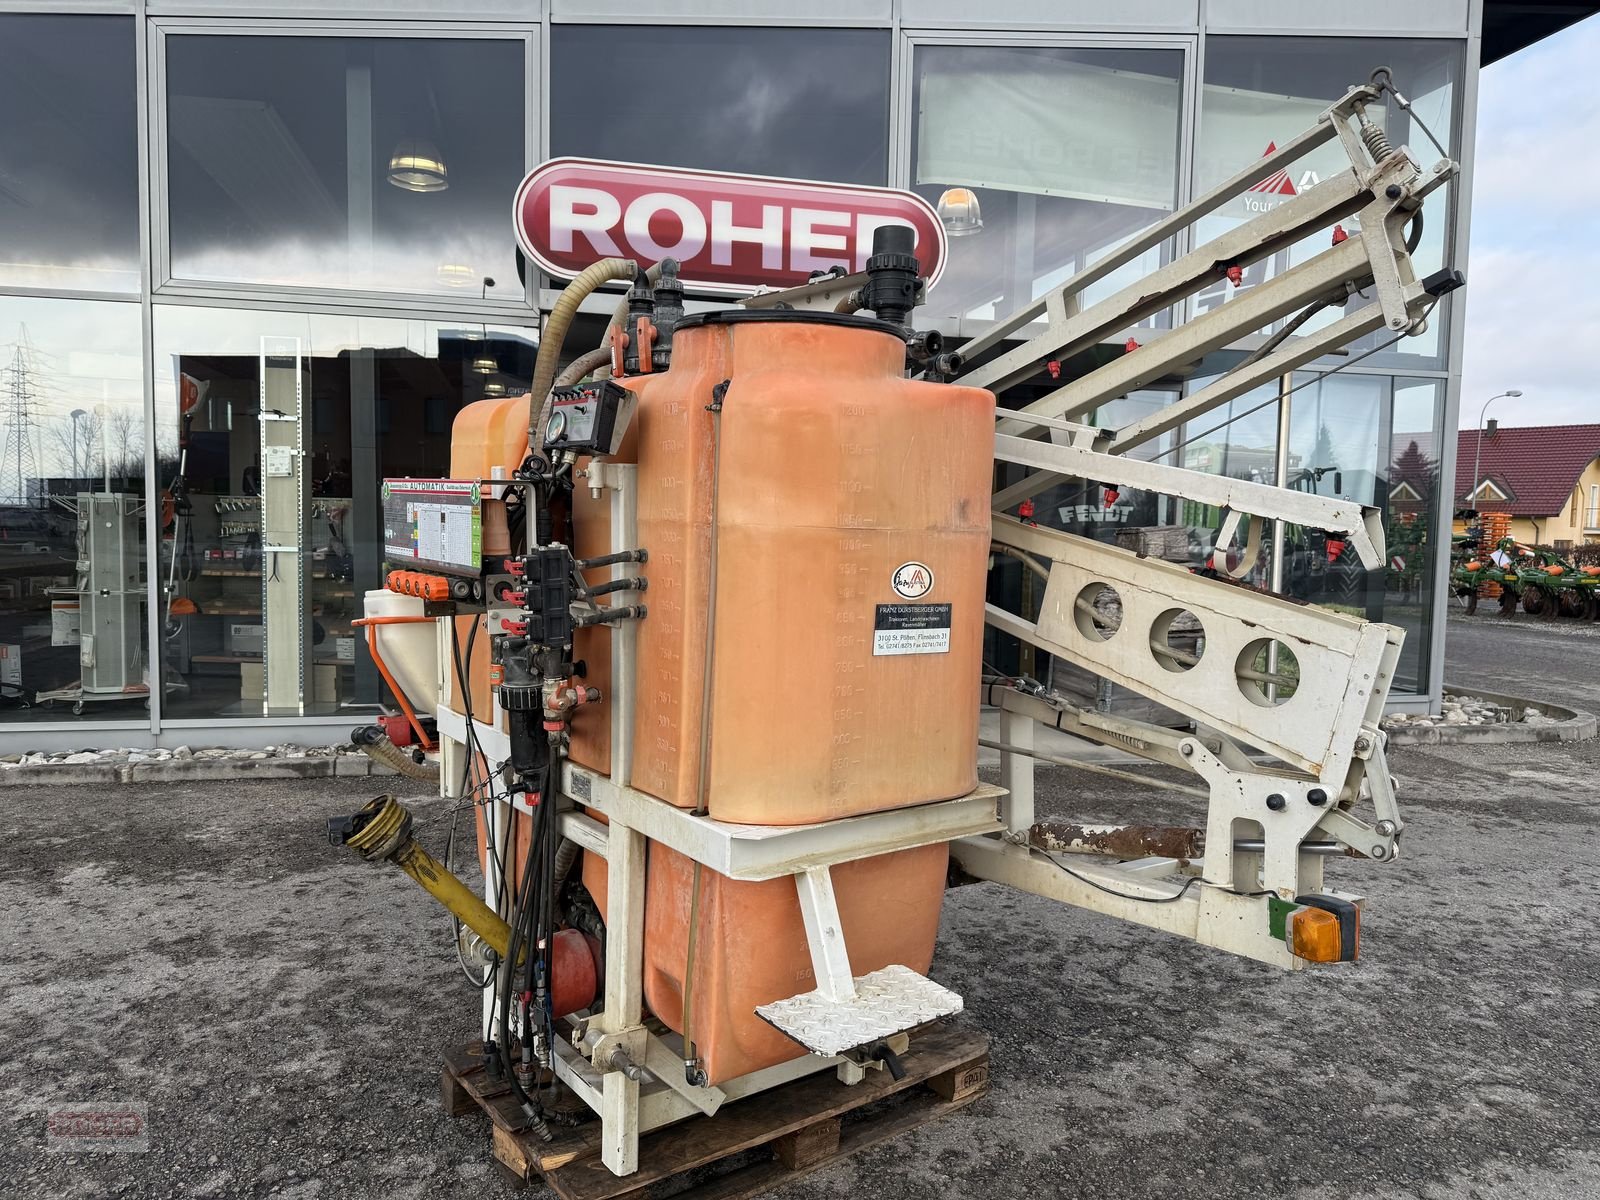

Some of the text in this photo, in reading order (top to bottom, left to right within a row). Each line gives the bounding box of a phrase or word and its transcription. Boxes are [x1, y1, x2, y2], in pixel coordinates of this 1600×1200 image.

[1245, 197, 1273, 213] Your
[410, 482, 445, 491] AUTOMATIK
[1058, 504, 1134, 524] FENDT
[878, 634, 891, 642] 3100
[796, 969, 812, 981] 150
